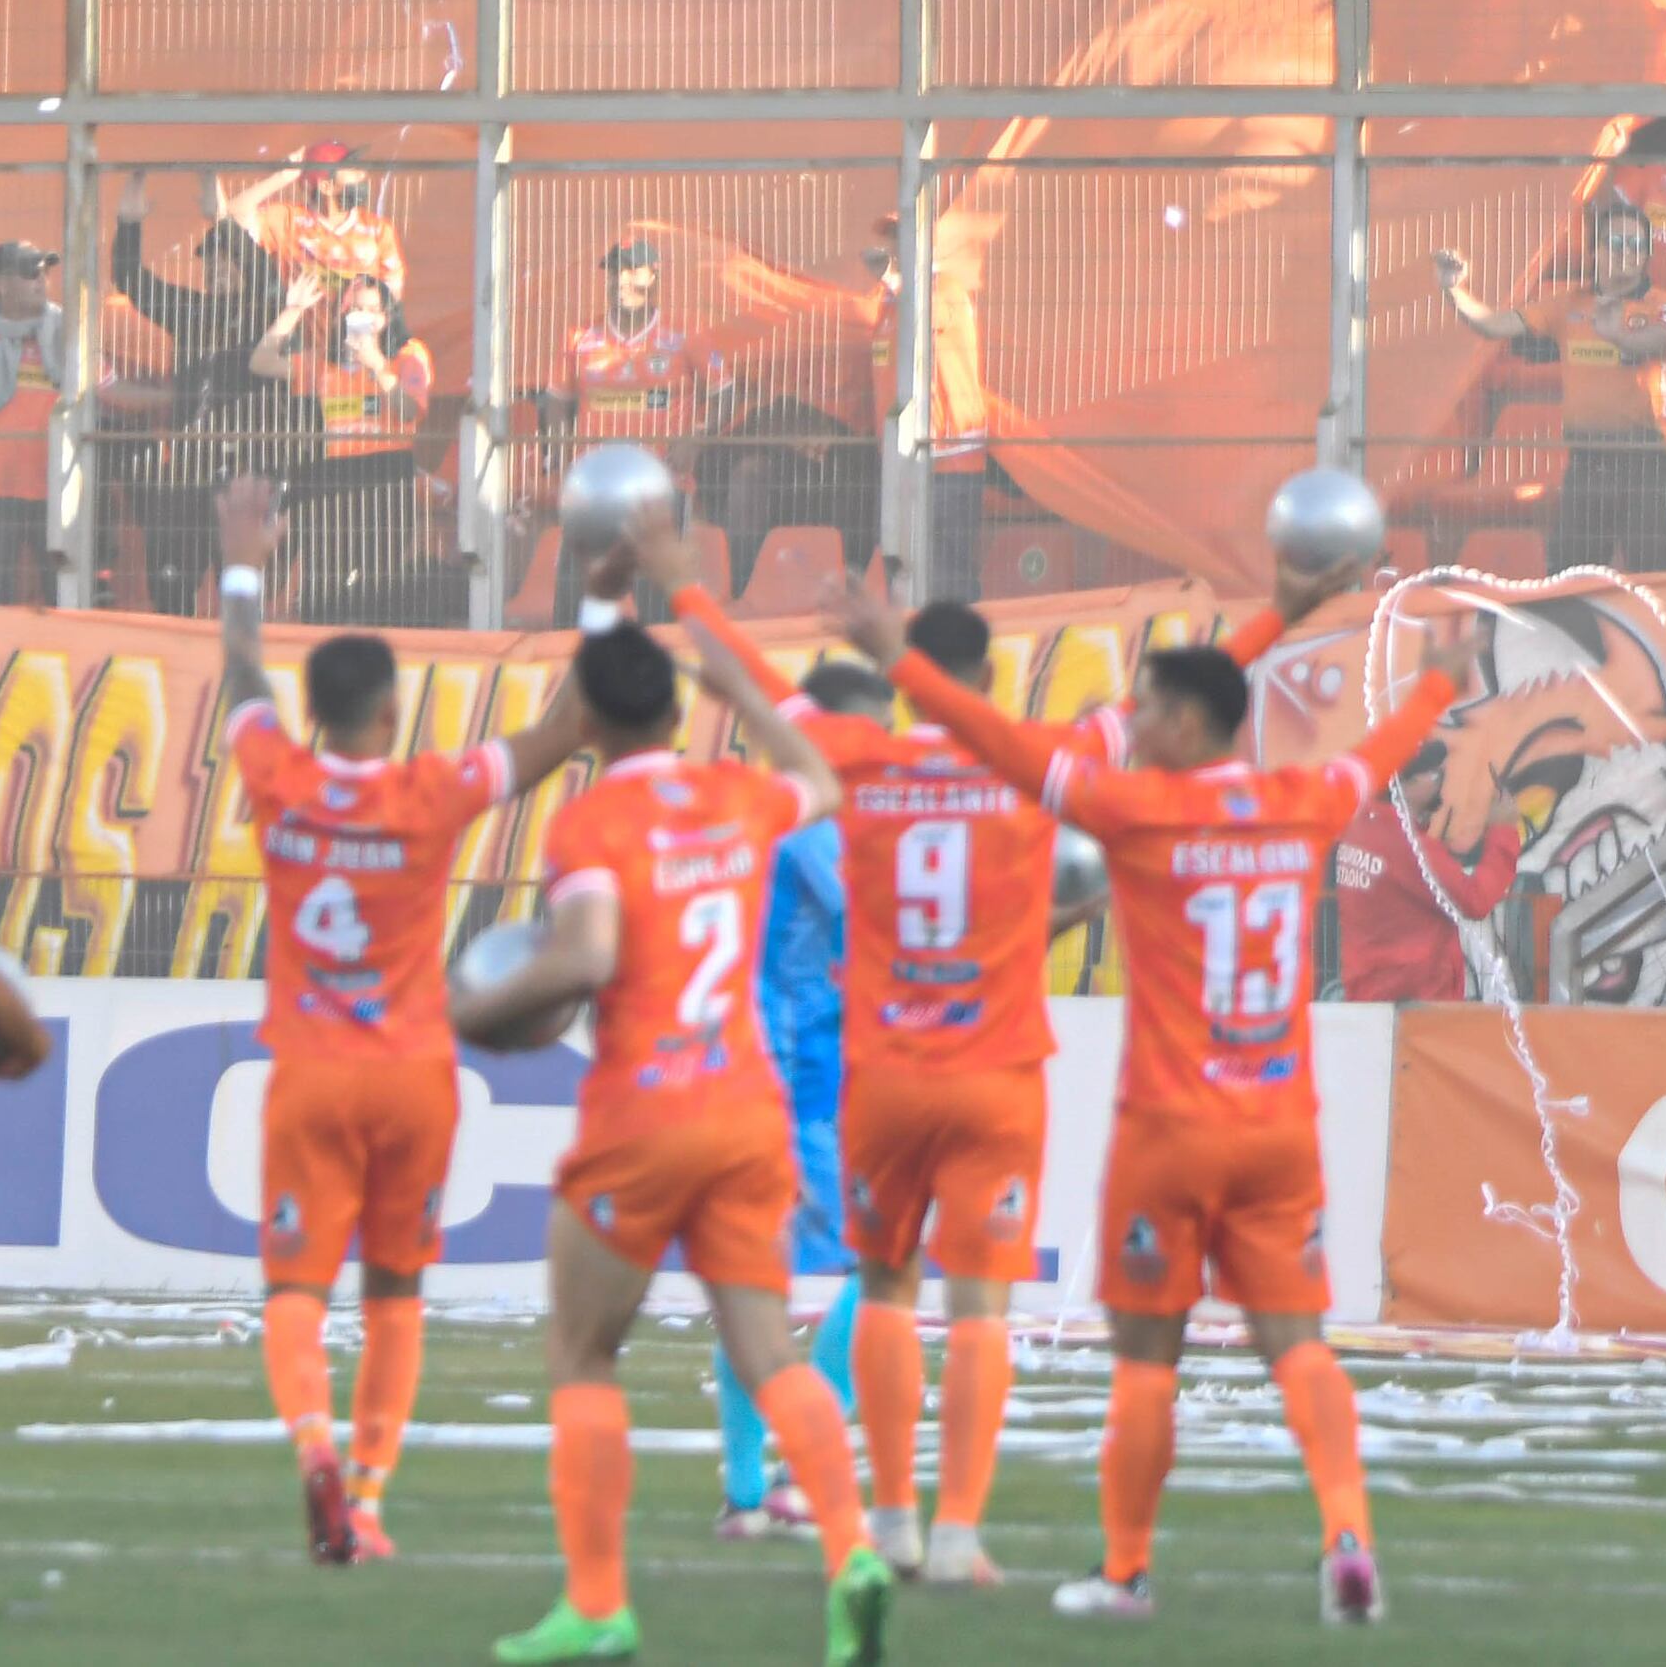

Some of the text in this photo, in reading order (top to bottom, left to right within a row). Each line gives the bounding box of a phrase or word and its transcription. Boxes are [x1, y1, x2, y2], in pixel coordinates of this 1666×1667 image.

[294, 874, 372, 963] 4
[896, 820, 970, 952] 9
[1185, 882, 1301, 1016] 13
[678, 889, 741, 1025] 2
